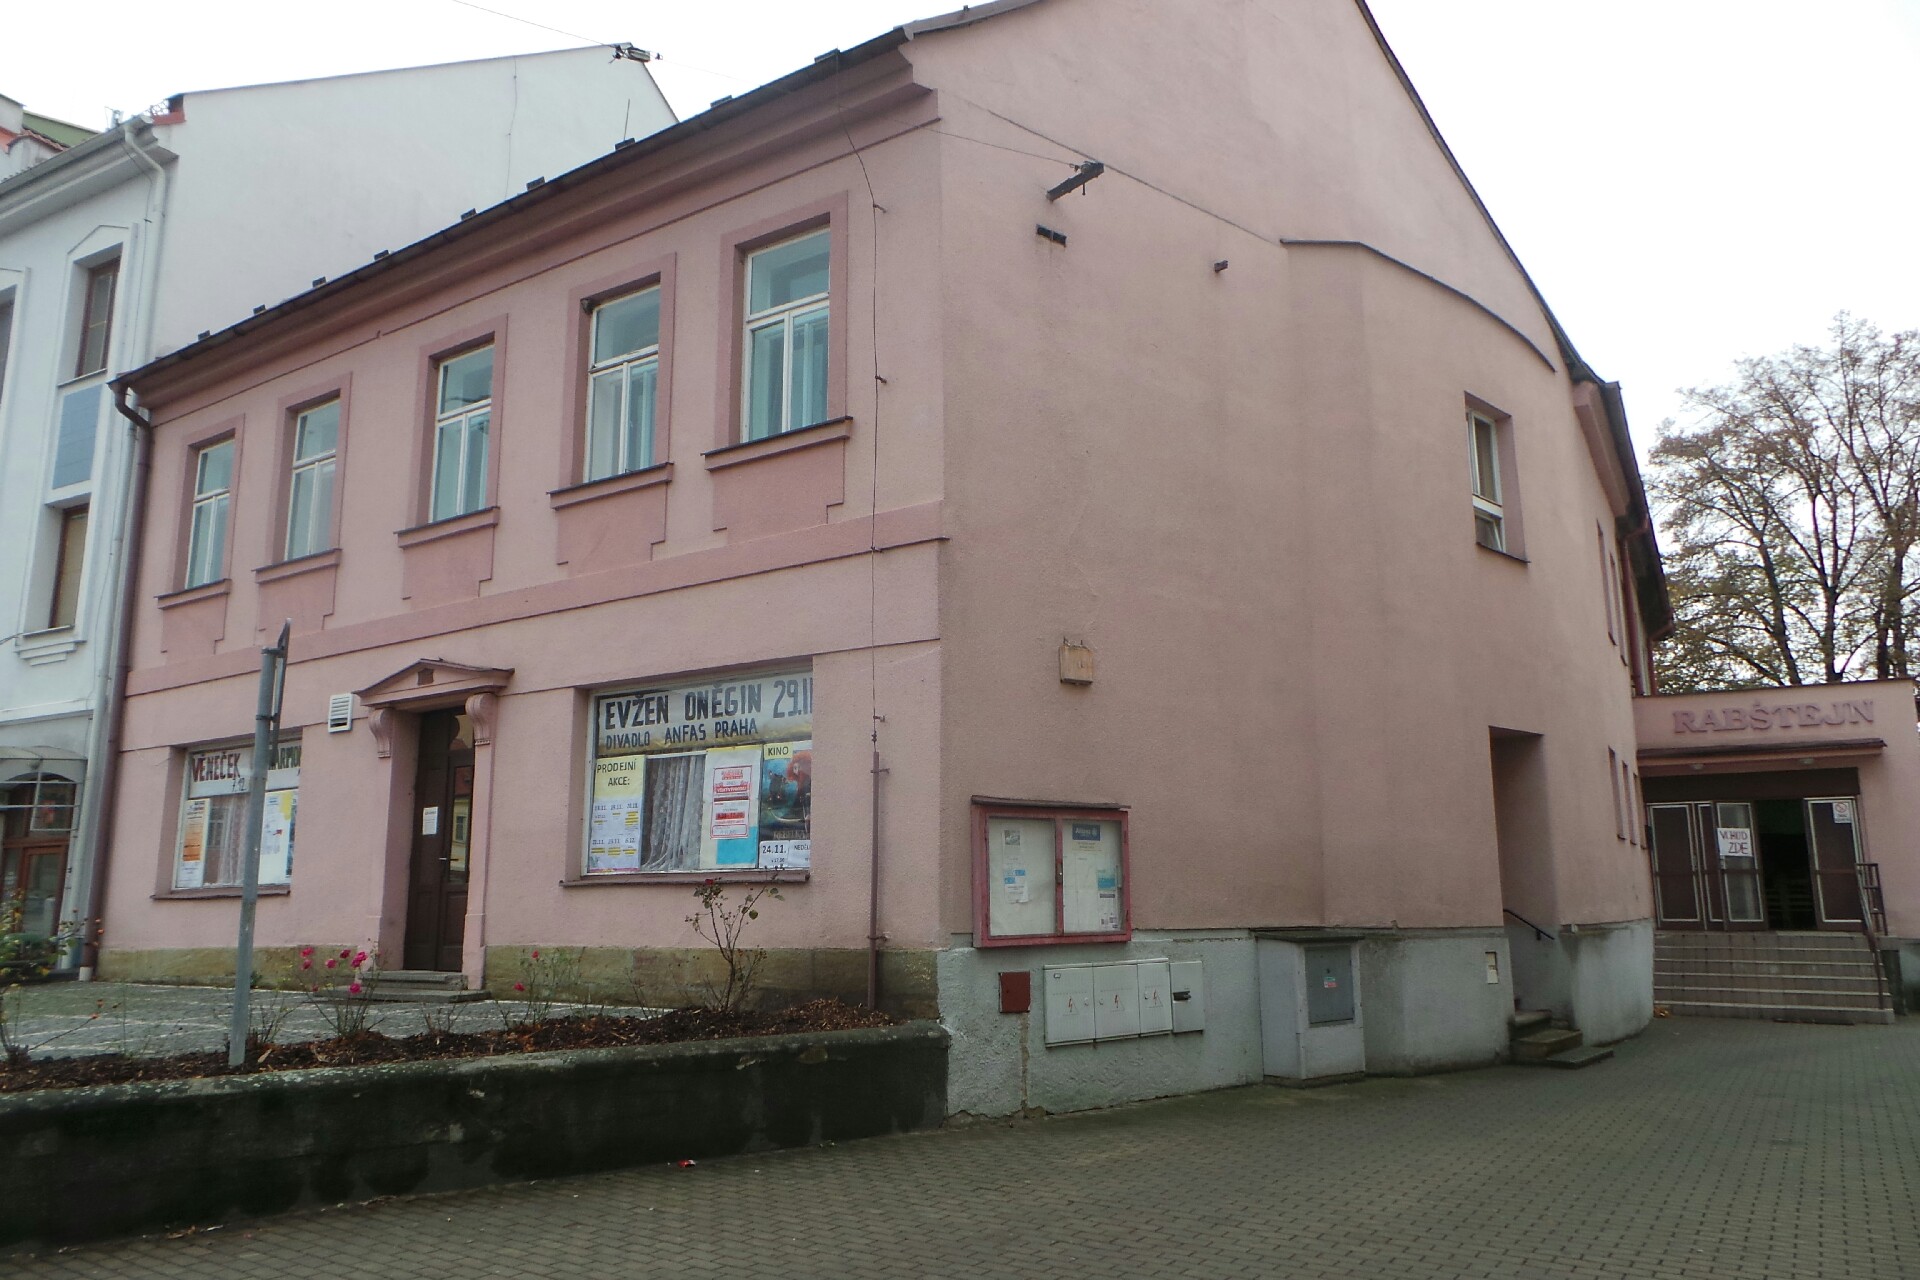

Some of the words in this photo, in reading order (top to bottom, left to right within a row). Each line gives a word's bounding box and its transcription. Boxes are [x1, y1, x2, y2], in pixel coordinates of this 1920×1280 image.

[605, 692, 669, 730] EVŽEN
[684, 681, 762, 721] ONĚGIN
[1672, 701, 1875, 734] RABŠTEJN
[606, 731, 650, 750] DIVADLO
[664, 723, 707, 745] ANFAS
[714, 717, 759, 739] PRAHA
[767, 746, 789, 757] KINO
[596, 758, 636, 774] PRODEJNÍ
[607, 776, 631, 787] AKCE:
[762, 844, 787, 854] 24.11.
[1728, 842, 1749, 855] ZDE
